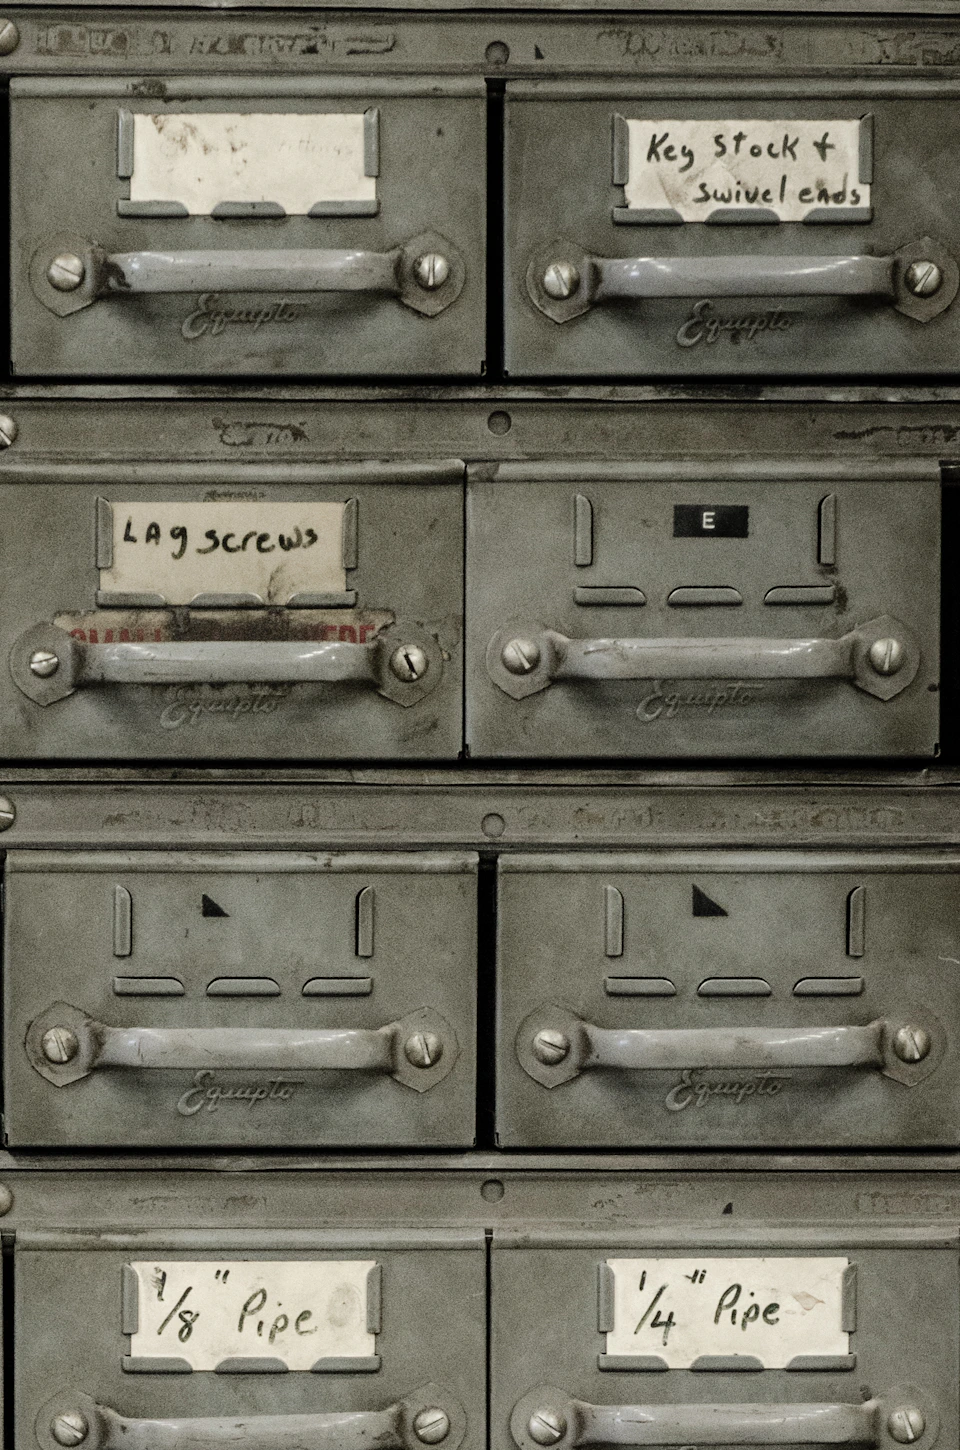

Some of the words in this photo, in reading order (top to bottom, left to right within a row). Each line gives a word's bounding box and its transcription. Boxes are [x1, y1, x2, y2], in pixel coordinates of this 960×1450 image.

[646, 132, 695, 173] Key
[798, 171, 862, 206] ends
[702, 512, 716, 530] E
[237, 1288, 318, 1344] Pipe
[714, 1283, 780, 1330] Pipe
